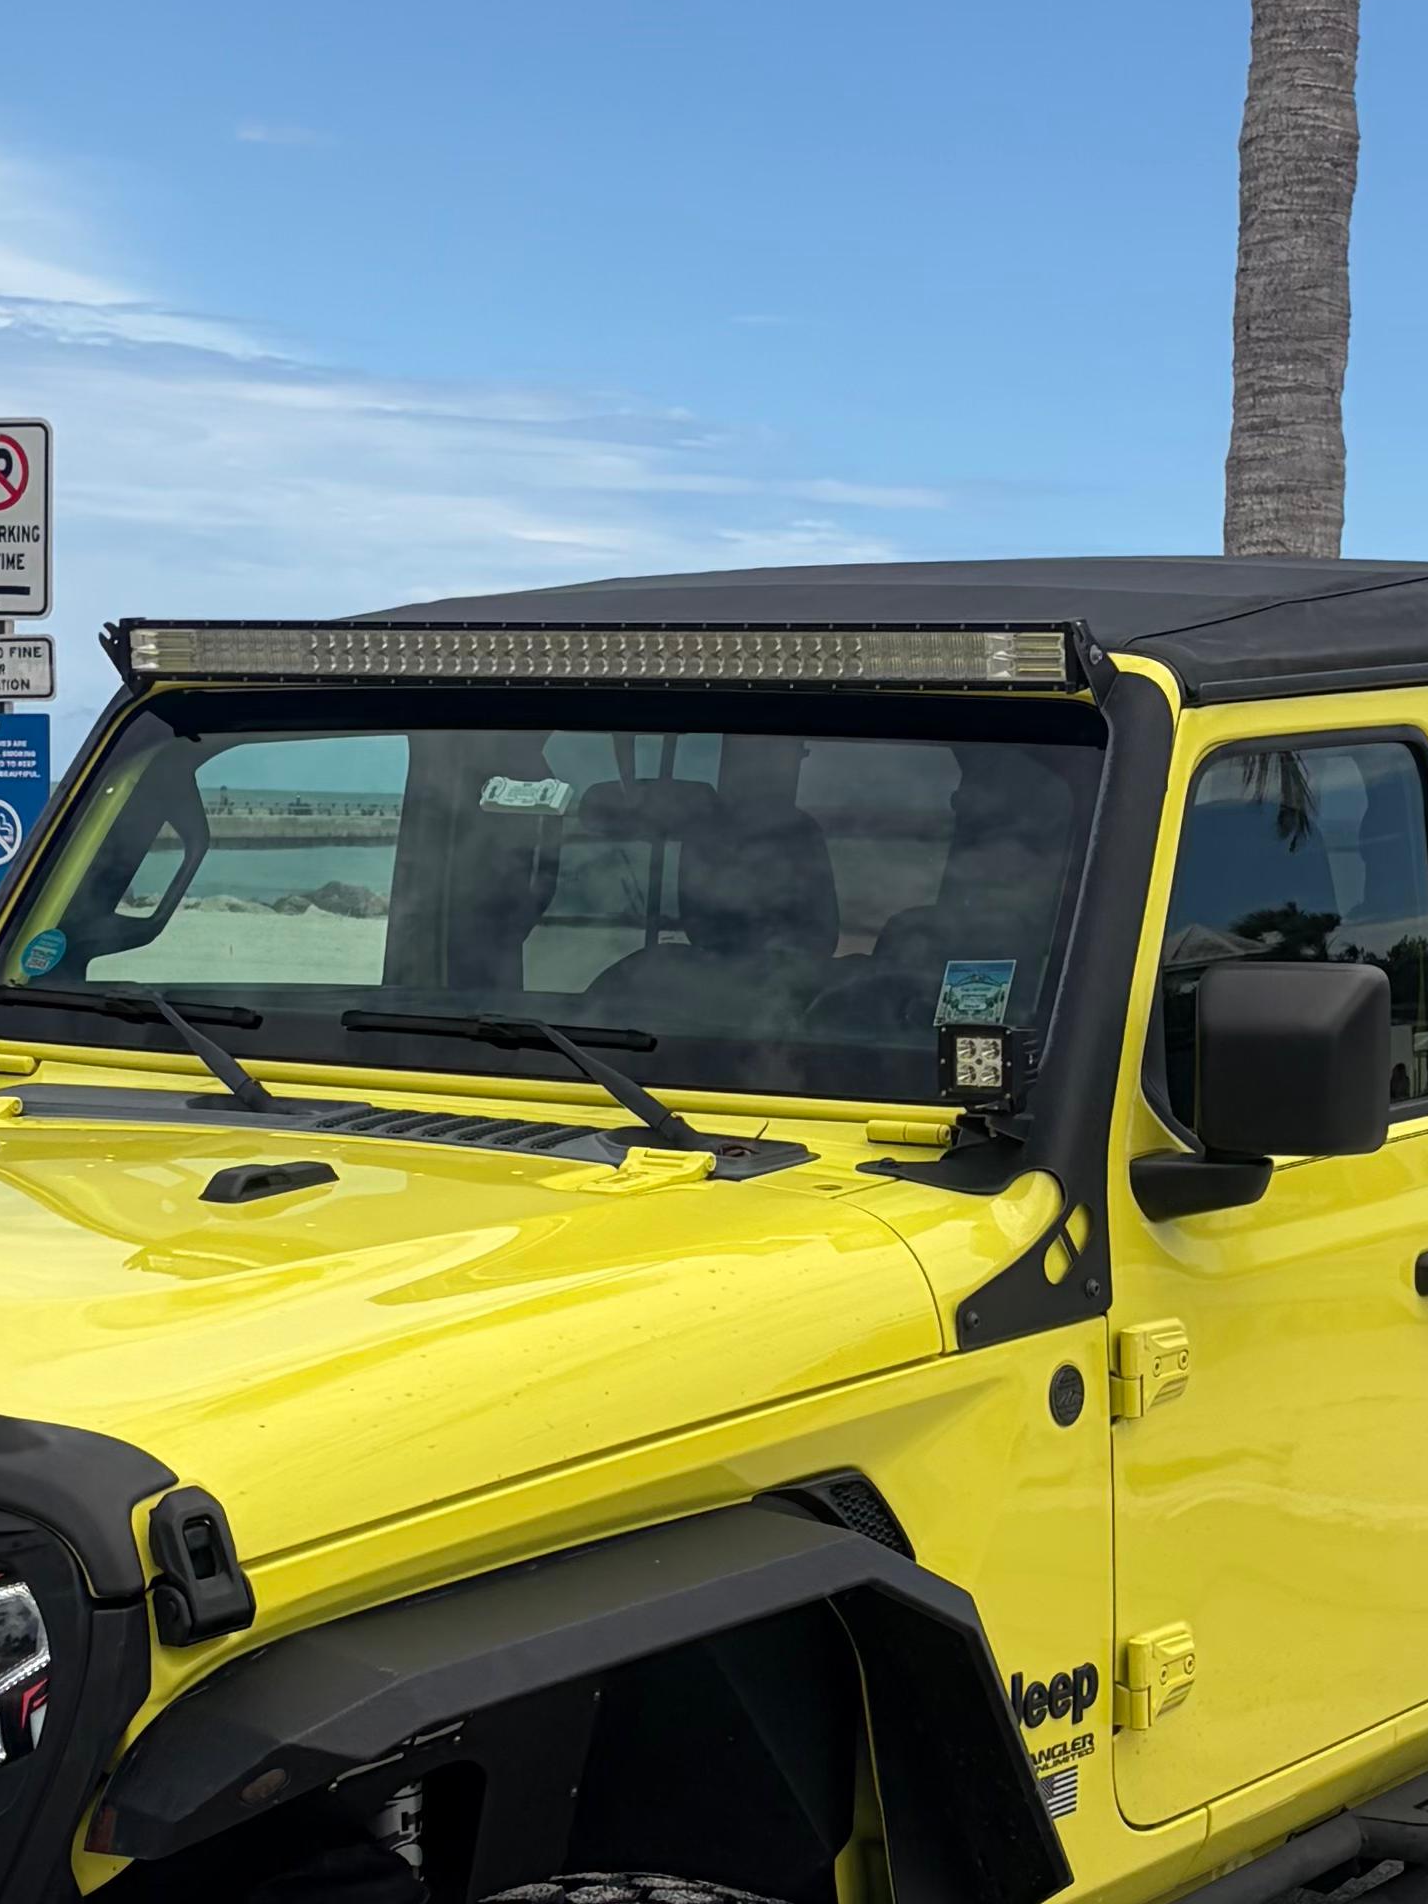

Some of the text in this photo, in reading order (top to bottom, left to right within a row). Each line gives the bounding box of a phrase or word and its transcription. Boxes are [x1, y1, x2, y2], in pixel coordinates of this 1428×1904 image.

[9, 646, 42, 658] FINE
[1011, 1662, 1098, 1728] Jeep
[1030, 1733, 1094, 1765] ANGLER
[1036, 1746, 1095, 1772] NLIMITED
